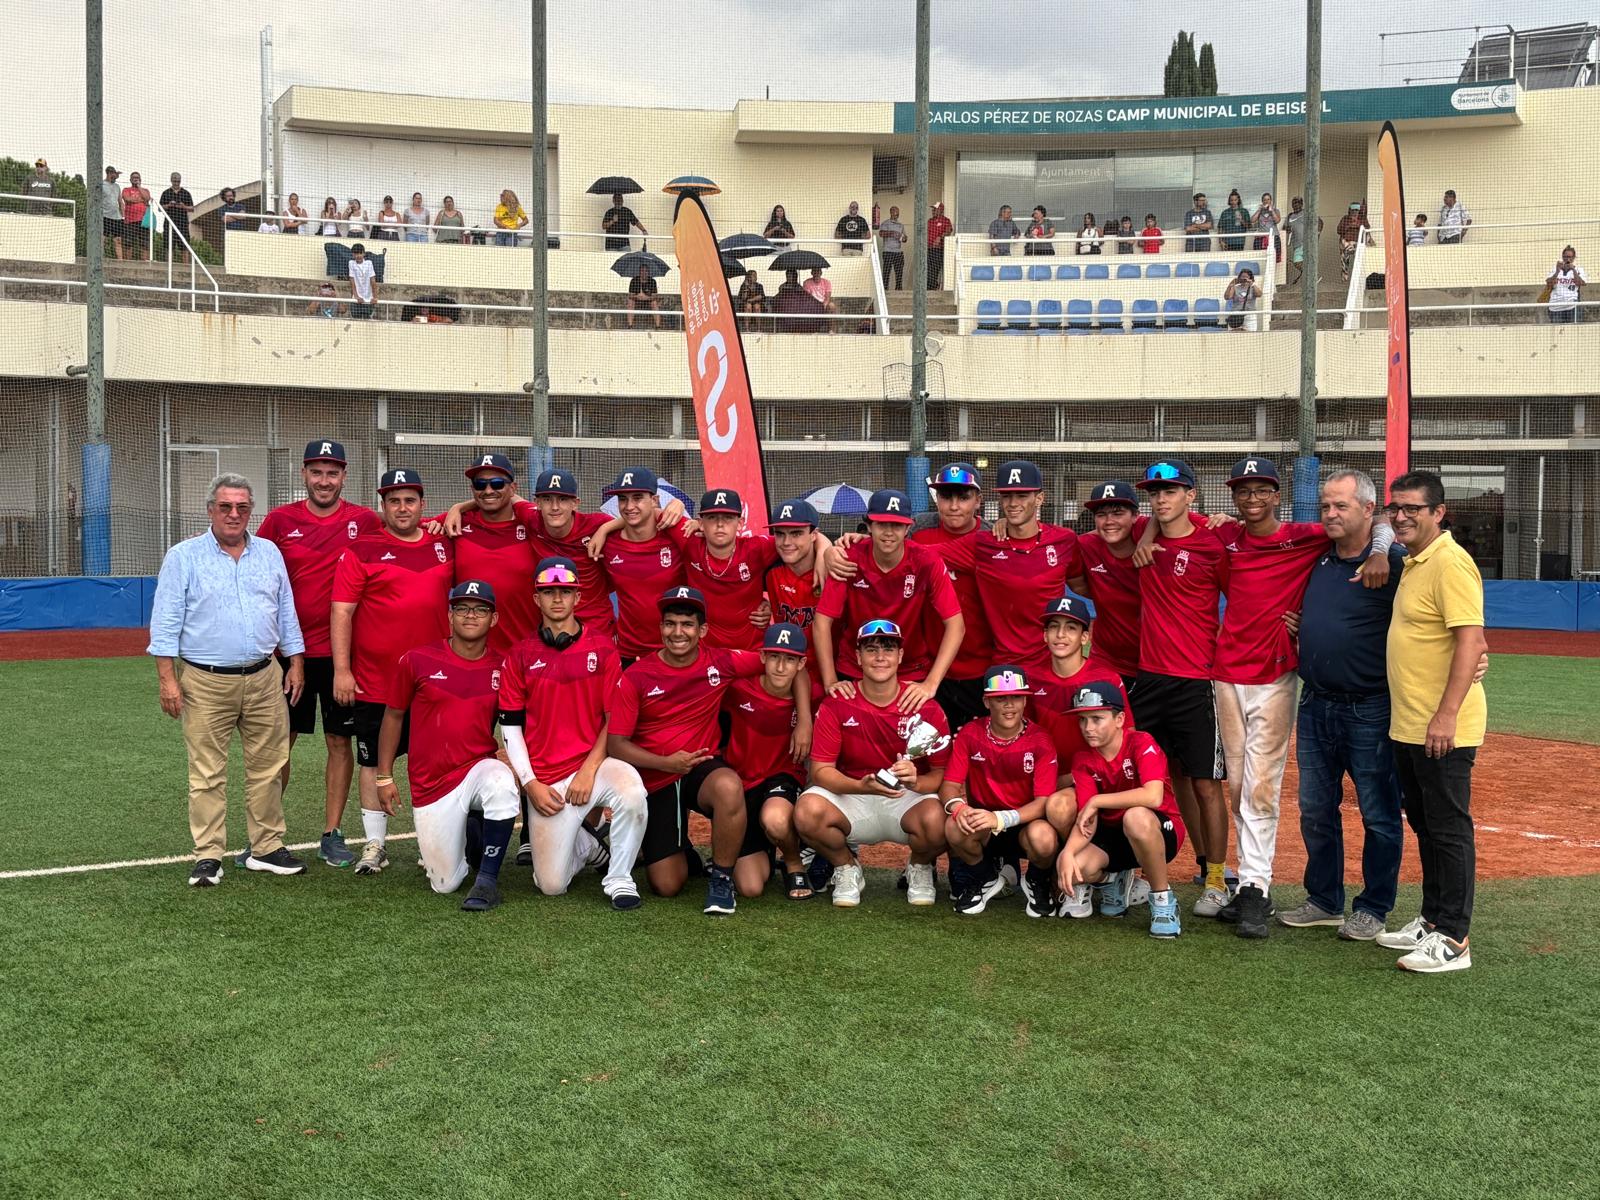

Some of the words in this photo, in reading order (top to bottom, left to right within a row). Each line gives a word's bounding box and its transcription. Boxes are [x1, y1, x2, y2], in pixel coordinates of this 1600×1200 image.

[984, 108, 1029, 124] PÉREZ
[1033, 111, 1052, 124] DE
[1055, 109, 1103, 123] ROZAS
[1106, 108, 1150, 122] CAMP
[1153, 104, 1237, 120] MUNICIPAL
[1241, 103, 1261, 117] DE
[1265, 100, 1332, 115] BEISBL
[1041, 167, 1101, 179] Ajuntament
